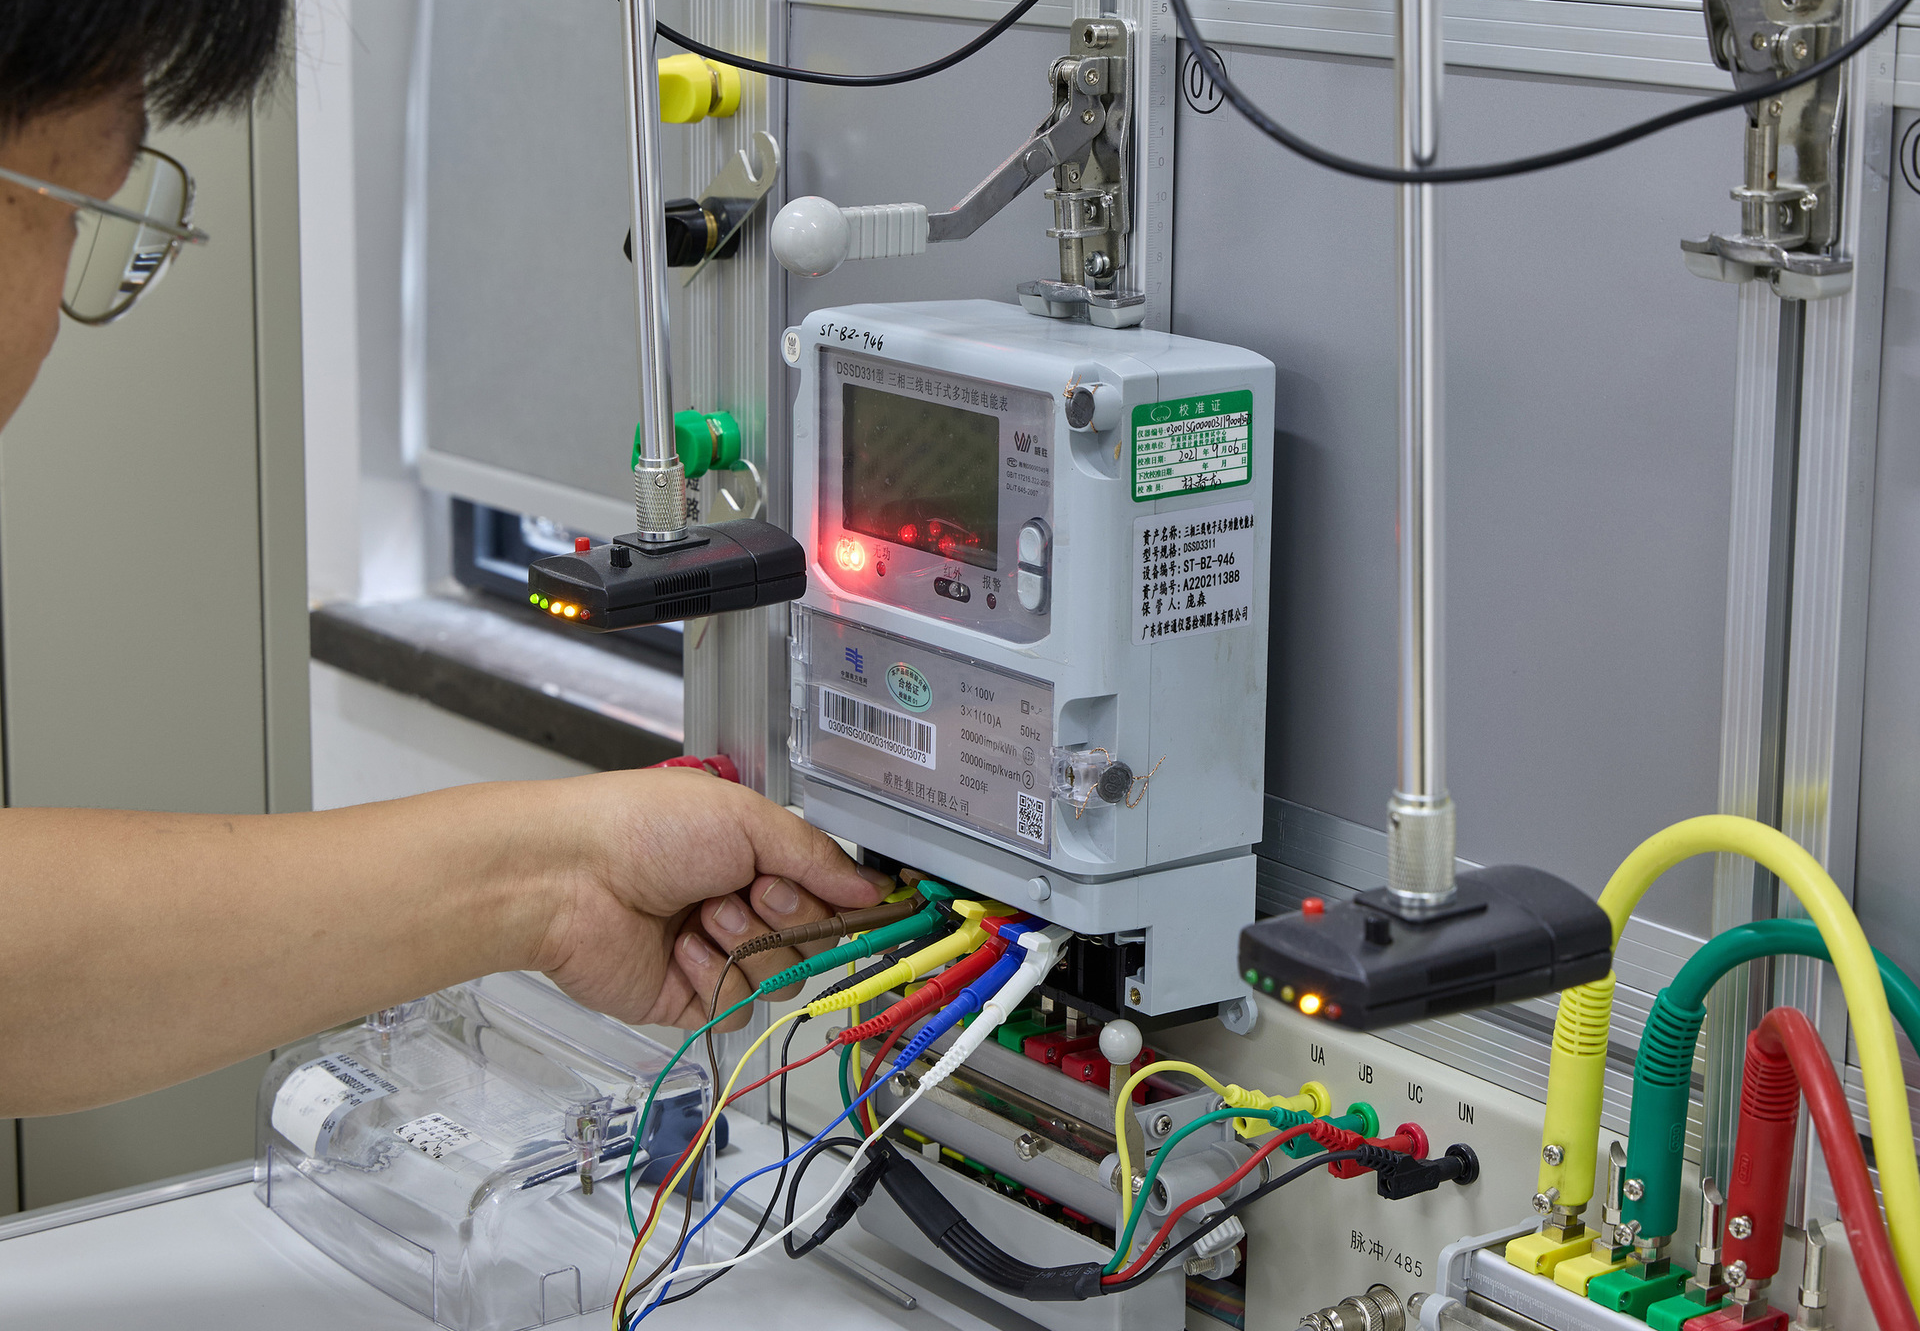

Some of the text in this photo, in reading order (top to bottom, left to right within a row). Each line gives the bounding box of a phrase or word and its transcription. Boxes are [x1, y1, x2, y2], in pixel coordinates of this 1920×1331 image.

[836, 361, 1008, 412] DSSD331型 三相三线电子式多功能电能表
[1179, 399, 1221, 416] 校准证
[1179, 447, 1198, 462] 2021
[1203, 448, 1209, 456] 年
[1221, 446, 1226, 454] 月
[1241, 442, 1247, 451] 日
[1202, 462, 1208, 470] 年
[1221, 459, 1226, 467] 月
[1241, 456, 1247, 464] 日
[873, 544, 891, 561] 无功
[1142, 538, 1216, 564] 型号规格: DSSD3311
[943, 564, 962, 582] 红外
[1142, 552, 1235, 581] 设备编号: ST-BZ-946
[982, 574, 1002, 593] 报警
[1182, 569, 1240, 592] A220211388
[1142, 606, 1248, 640] 广东省世通仪器检测服务有限公司
[898, 677, 919, 696] 合格证
[828, 719, 927, 764] 03001SG00000311900013073
[960, 728, 1017, 758] 20000imp/kWh
[1020, 725, 1041, 742] 50Hz
[960, 751, 1021, 782] 20000imp/kvarh
[883, 771, 969, 816] 威胜集团有限公司
[959, 774, 989, 795] 2020年
[1310, 1043, 1325, 1066] UA
[1358, 1062, 1374, 1085] UB
[1408, 1081, 1423, 1104] UC
[1458, 1101, 1474, 1125] UN
[1350, 1229, 1423, 1278] 脉冲/485
